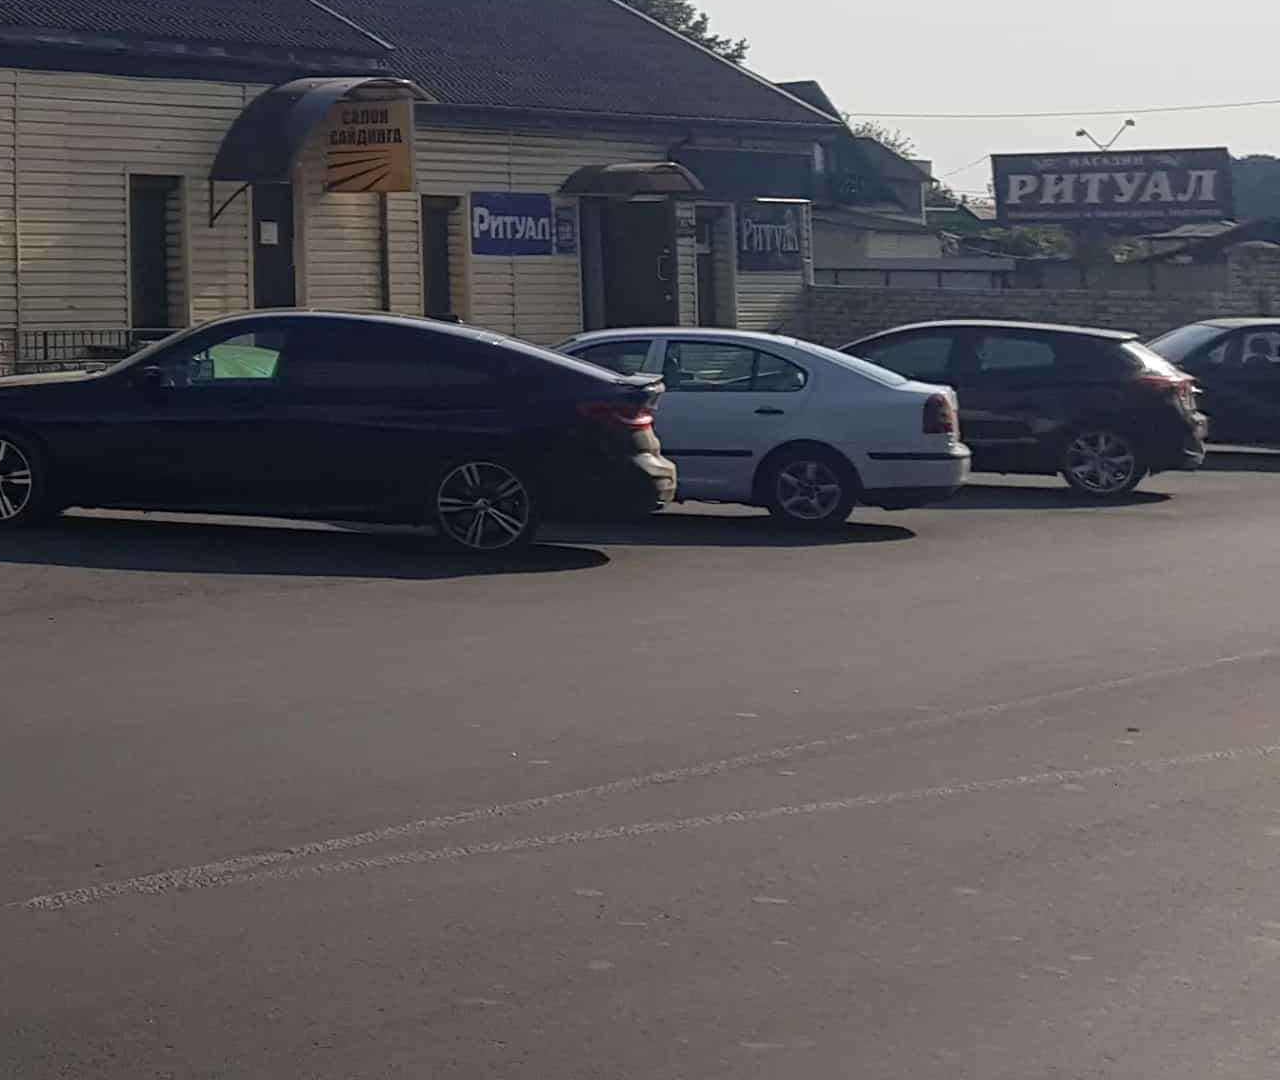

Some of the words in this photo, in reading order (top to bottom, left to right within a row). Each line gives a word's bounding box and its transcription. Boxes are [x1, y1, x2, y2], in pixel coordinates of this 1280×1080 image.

[343, 108, 389, 125] САЛОН
[329, 126, 402, 145] САЙДИНГА
[1069, 156, 1145, 168] МАГАЗИН
[1005, 168, 1219, 205] РИТУАЛ
